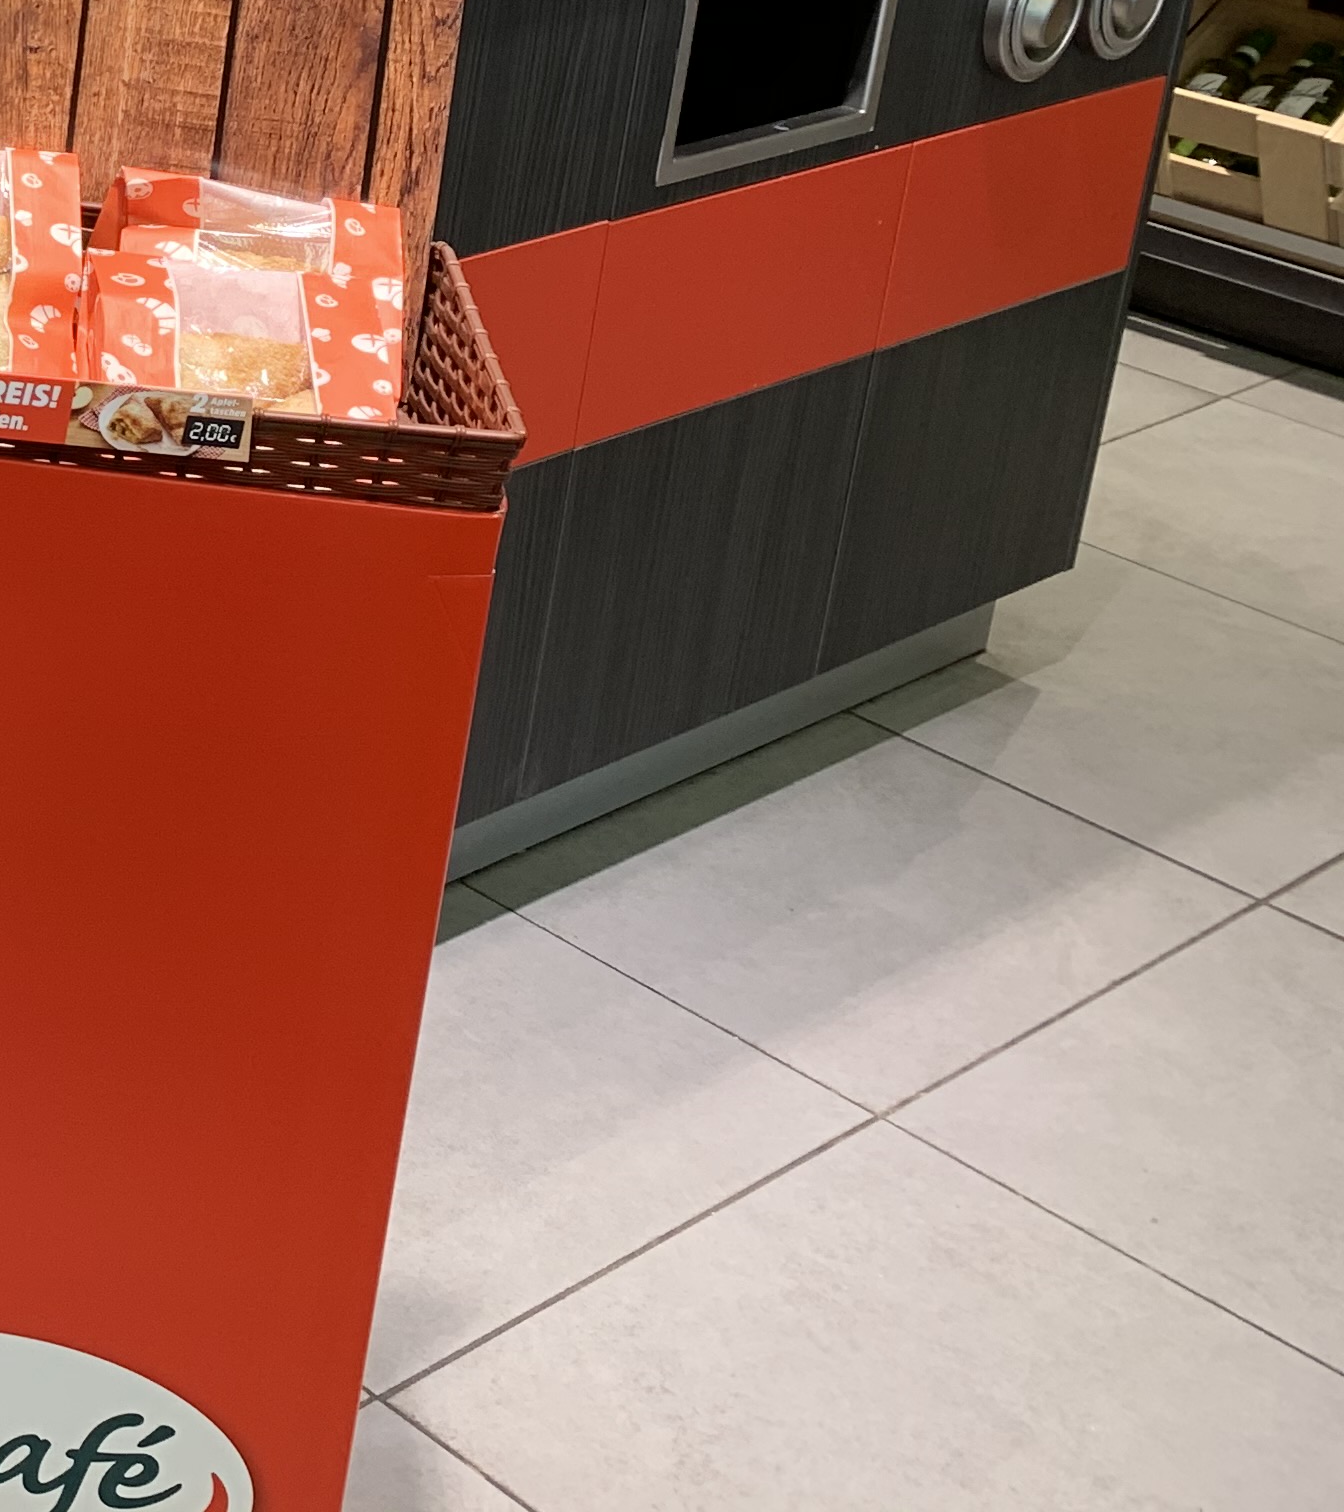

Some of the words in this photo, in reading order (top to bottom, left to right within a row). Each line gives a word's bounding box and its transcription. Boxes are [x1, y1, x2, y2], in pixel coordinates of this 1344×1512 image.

[190, 393, 209, 413] 2
[211, 397, 240, 407] Apfel-
[210, 408, 246, 417] taschen
